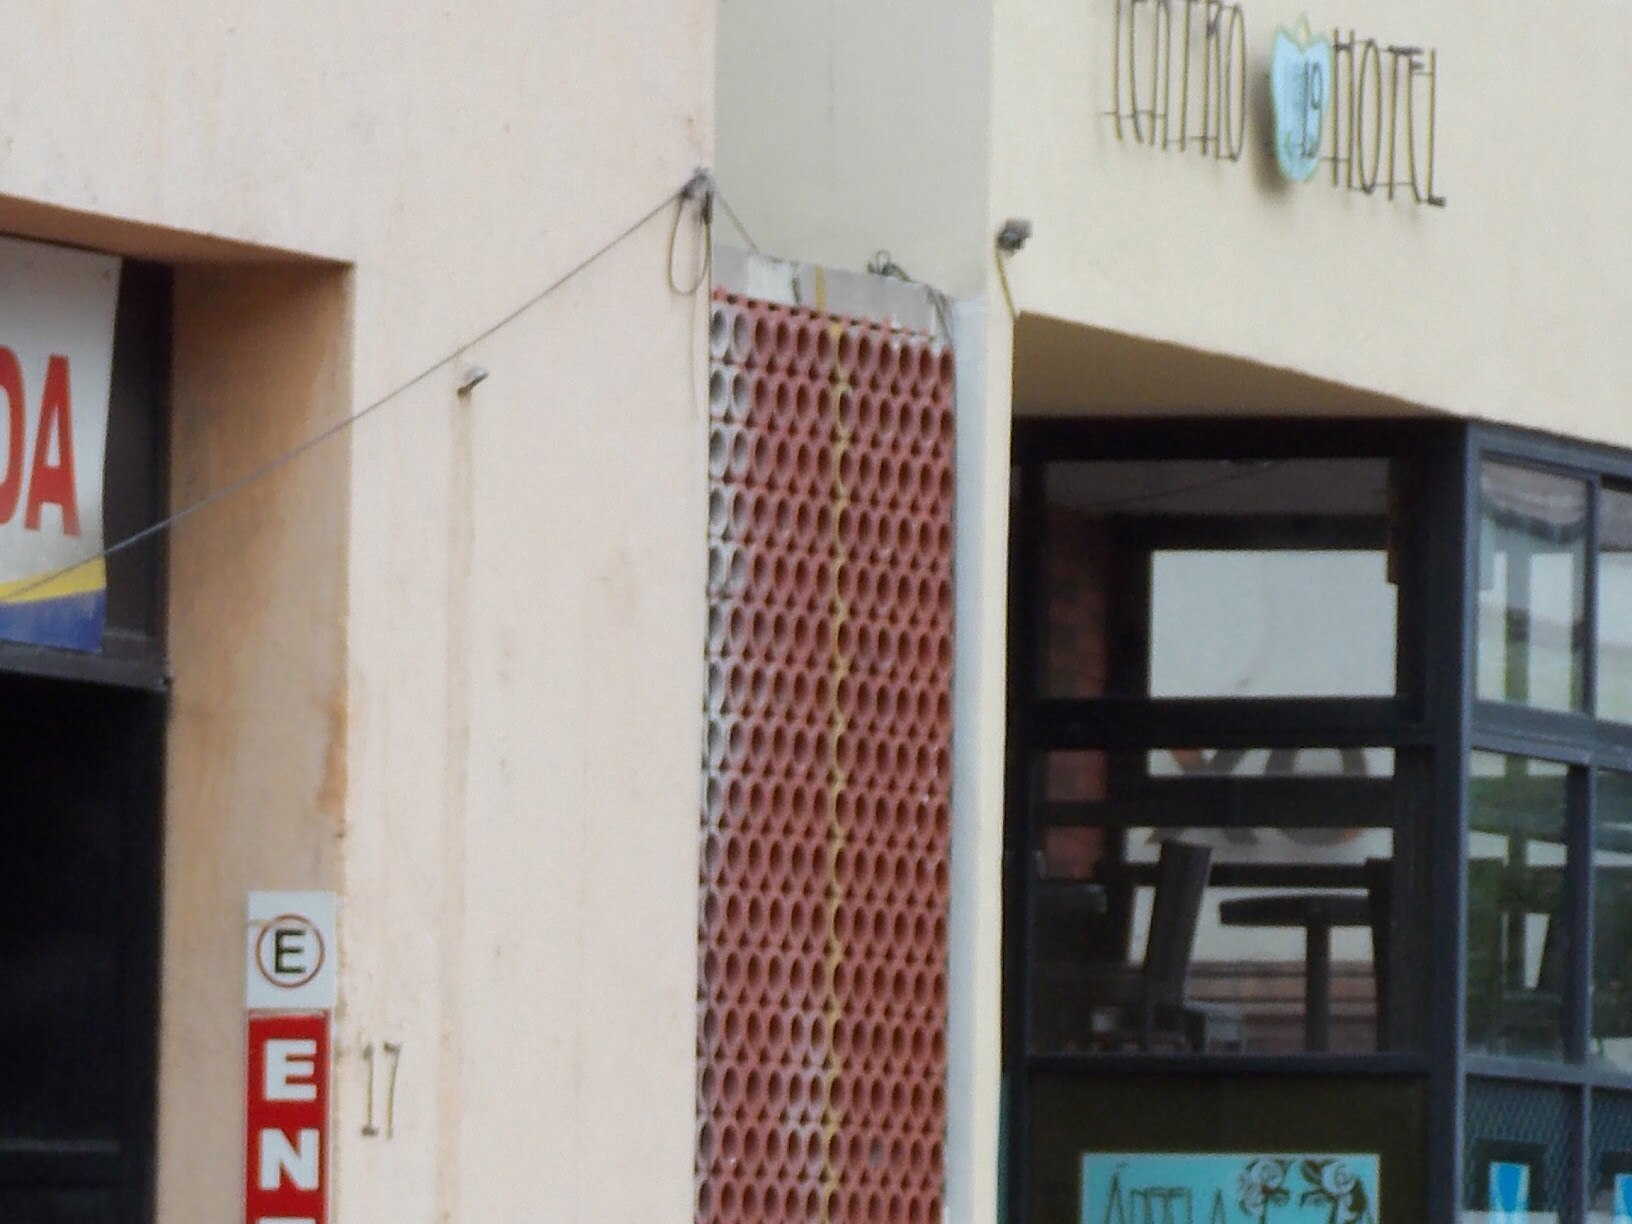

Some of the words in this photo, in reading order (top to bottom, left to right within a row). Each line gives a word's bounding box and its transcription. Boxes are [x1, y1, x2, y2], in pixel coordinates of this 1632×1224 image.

[1331, 27, 1446, 208] HOTEL
[273, 929, 307, 975] E
[361, 1042, 402, 1139] 17
